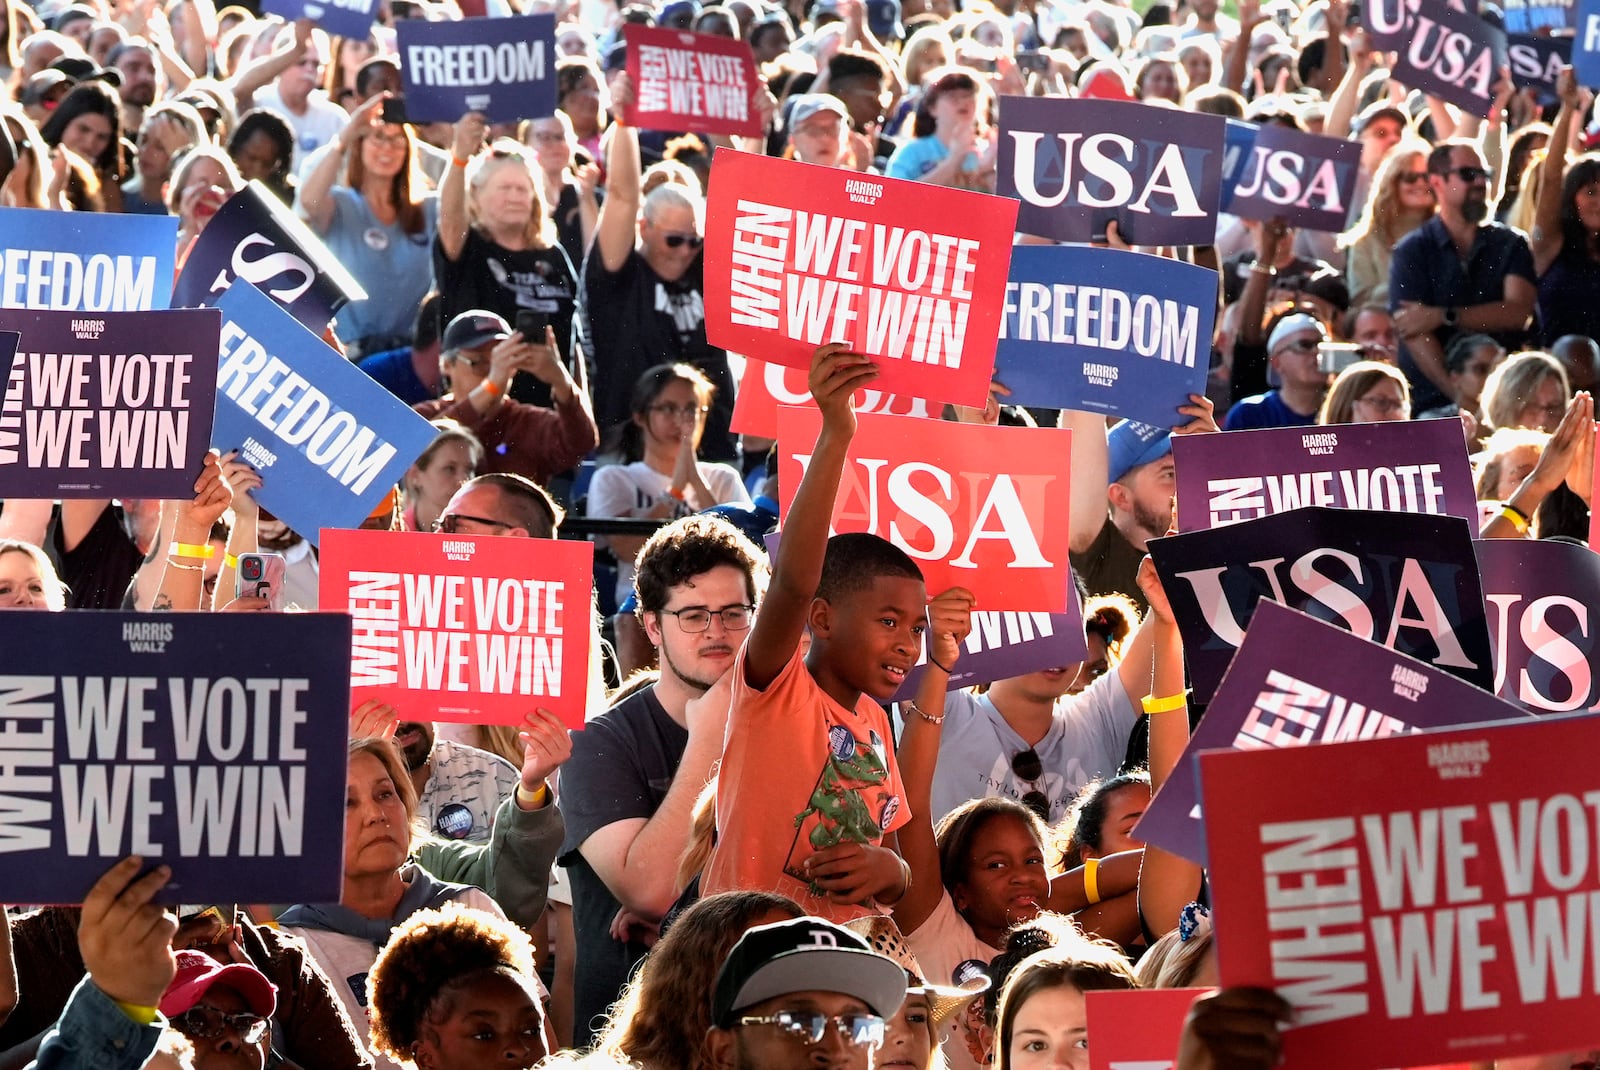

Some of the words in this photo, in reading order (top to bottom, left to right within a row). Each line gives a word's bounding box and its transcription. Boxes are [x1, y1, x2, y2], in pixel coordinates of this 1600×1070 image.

[408, 40, 545, 87] FREEDOM
[666, 48, 698, 80] WE
[697, 52, 747, 87] VOTE
[1408, 15, 1492, 100] USA
[1506, 44, 1564, 83] SA
[638, 44, 668, 113] WHEN
[669, 79, 704, 117] WE
[703, 82, 749, 122] WIN
[845, 179, 883, 198] HARRIS
[1008, 130, 1208, 217] USA
[850, 194, 876, 205] WALZ
[731, 199, 792, 330] WHEN
[795, 210, 866, 281] WE
[873, 223, 980, 300] VOTE
[0, 249, 157, 311] EEDOM
[71, 320, 105, 332] HARRIS
[76, 331, 100, 339] WALZ
[786, 273, 863, 350] WE
[866, 288, 970, 368] WIN
[999, 282, 1199, 368] FREEDOM
[29, 353, 93, 407] WE
[100, 353, 193, 408] VOTE
[1083, 363, 1119, 380] HARRIS
[1088, 376, 1113, 387] WALZ
[25, 410, 94, 468] WE
[99, 410, 190, 469] WIN
[242, 437, 278, 467] HARRIS
[242, 450, 265, 470] WALZ
[1302, 433, 1338, 448] HARRIS
[1309, 446, 1334, 455] WALZ
[1266, 471, 1336, 514] WE
[1340, 464, 1446, 516] VOTE
[442, 541, 475, 554] HARRIS
[447, 553, 470, 561] WALZ
[403, 574, 465, 629] WE
[472, 576, 564, 635] VOTE
[1174, 548, 1478, 669] USA
[122, 622, 173, 641] HARRIS
[130, 640, 166, 652] WALZ
[348, 571, 400, 687] WHEN
[402, 630, 470, 691] WE
[476, 634, 563, 697] WIN
[1391, 664, 1429, 694] HARRIS
[1393, 682, 1421, 702] WALZ
[61, 676, 158, 760] WE
[168, 677, 310, 761] VOTE
[0, 675, 55, 853] WHEN
[1427, 740, 1490, 767] HARRIS
[1438, 763, 1482, 780] WALZ
[979, 773, 1019, 799] TAYLO
[59, 764, 165, 857] WE
[173, 765, 306, 857] WIN
[438, 809, 469, 829] HARRIS
[446, 821, 467, 833] WALZ
[1361, 805, 1483, 911] WE
[1260, 816, 1369, 1032] WHEN
[1370, 904, 1500, 1019] WE
[1504, 890, 1600, 1004] WI
